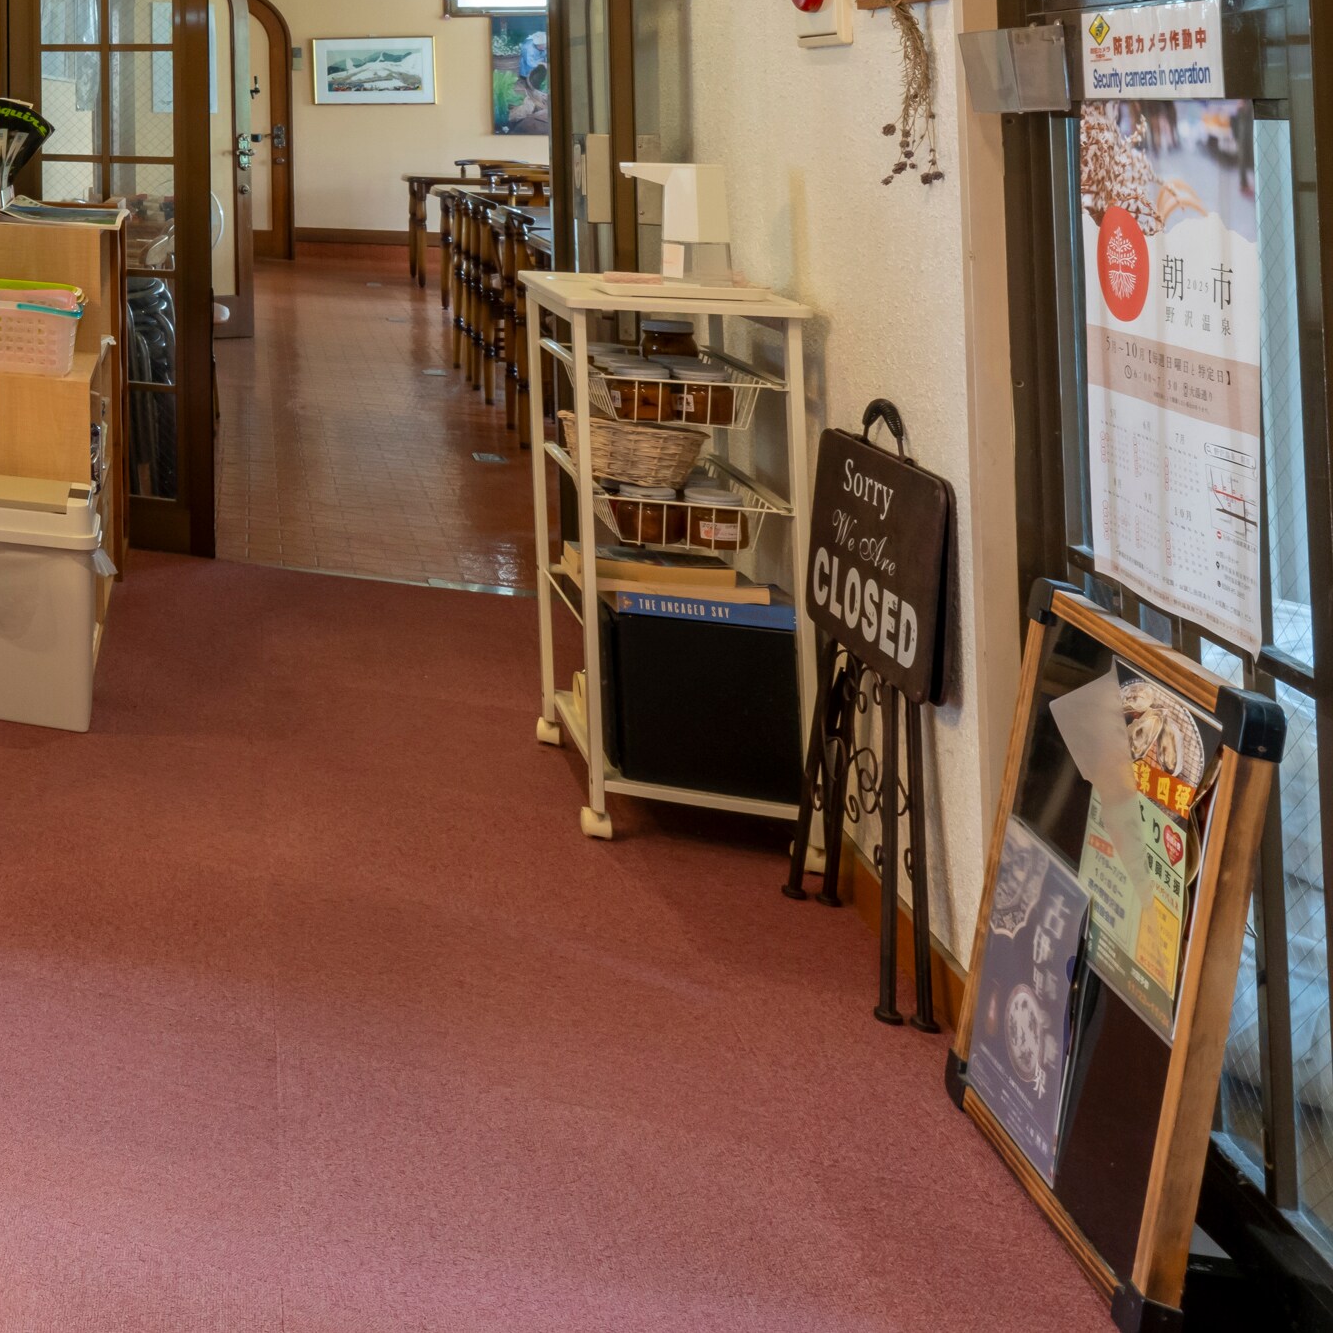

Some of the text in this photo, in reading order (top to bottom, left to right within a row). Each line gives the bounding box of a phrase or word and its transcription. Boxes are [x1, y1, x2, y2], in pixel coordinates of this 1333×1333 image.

[1112, 27, 1207, 56] 防犯カメラ作動中
[1092, 61, 1212, 93] Security cameras in operation
[1186, 279, 1209, 293] 2025
[1165, 306, 1232, 336] 野沢温泉
[843, 458, 894, 521] Sorry
[833, 509, 896, 576] We Are
[638, 598, 731, 619] THE UNCAGED SKY
[813, 546, 918, 669] CLOSED
